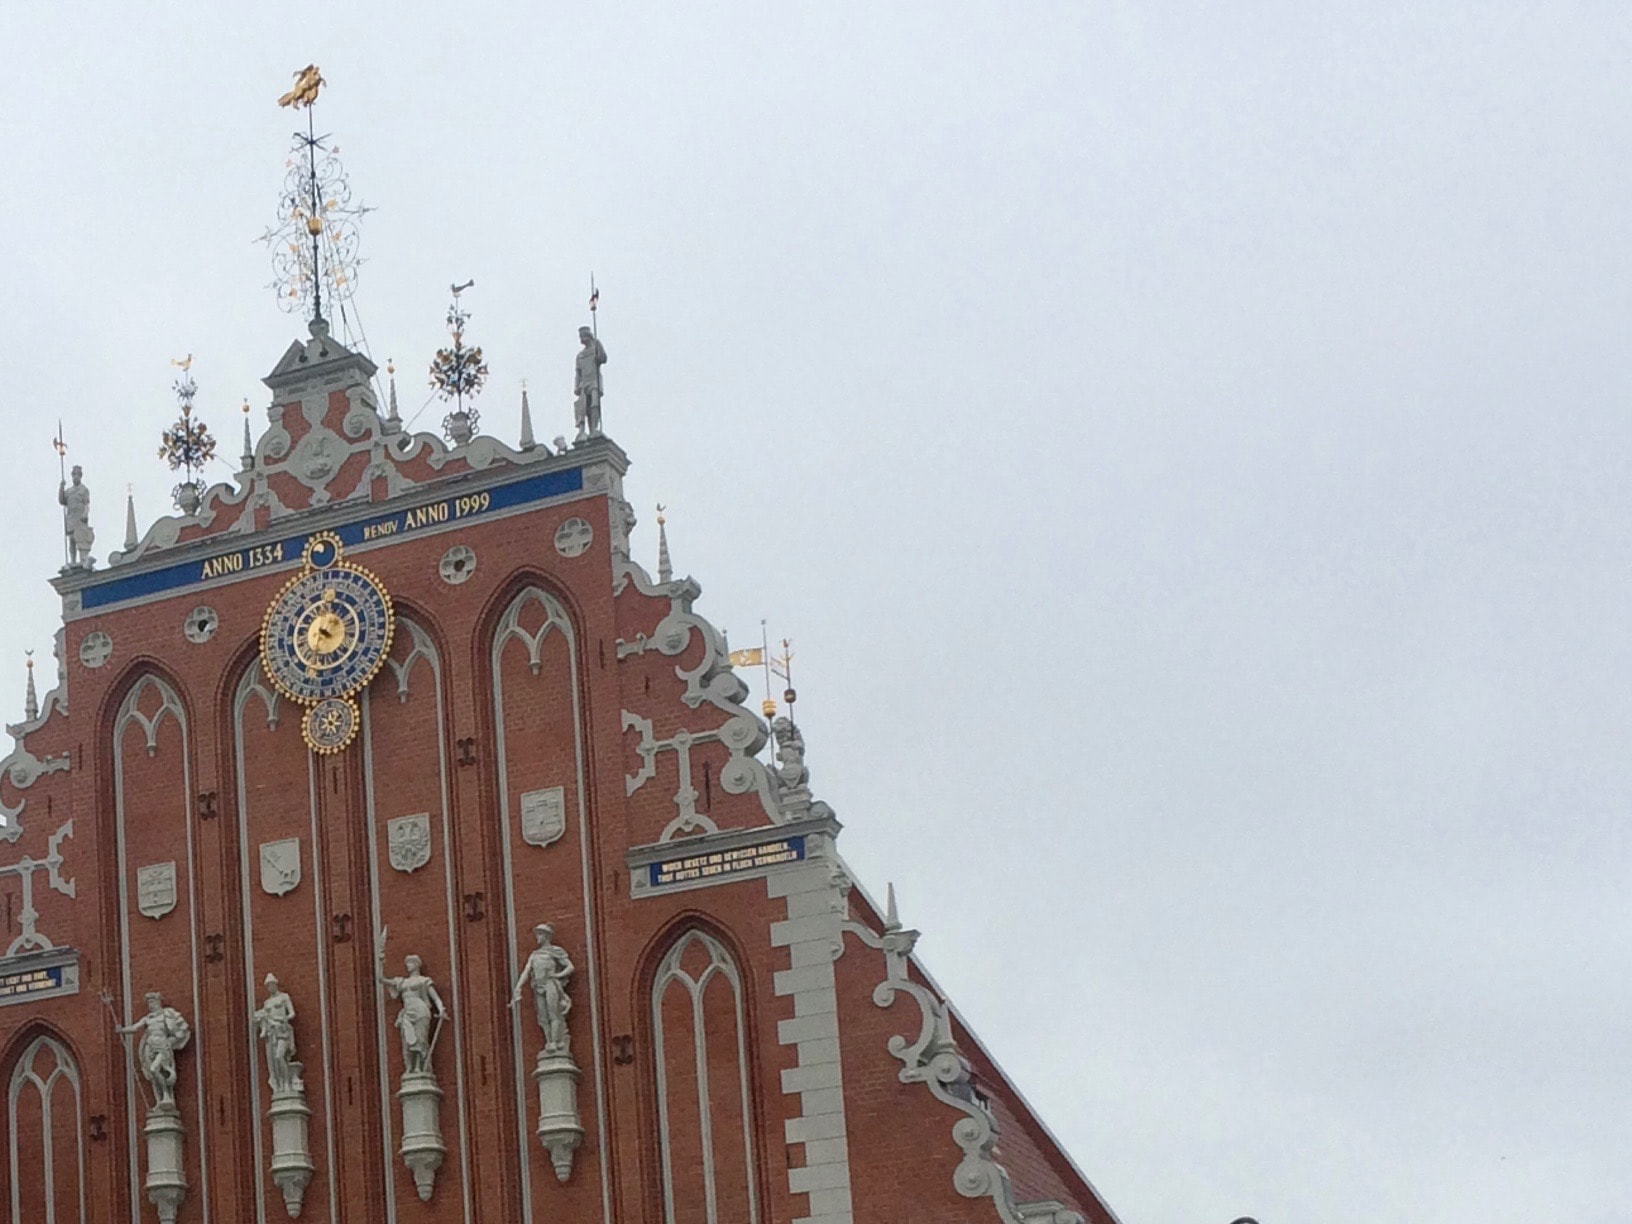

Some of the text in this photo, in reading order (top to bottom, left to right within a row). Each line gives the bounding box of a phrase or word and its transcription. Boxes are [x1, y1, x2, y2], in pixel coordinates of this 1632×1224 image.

[363, 493, 490, 541] RENOV ANNO 1999
[200, 543, 283, 579] ANNO 1334
